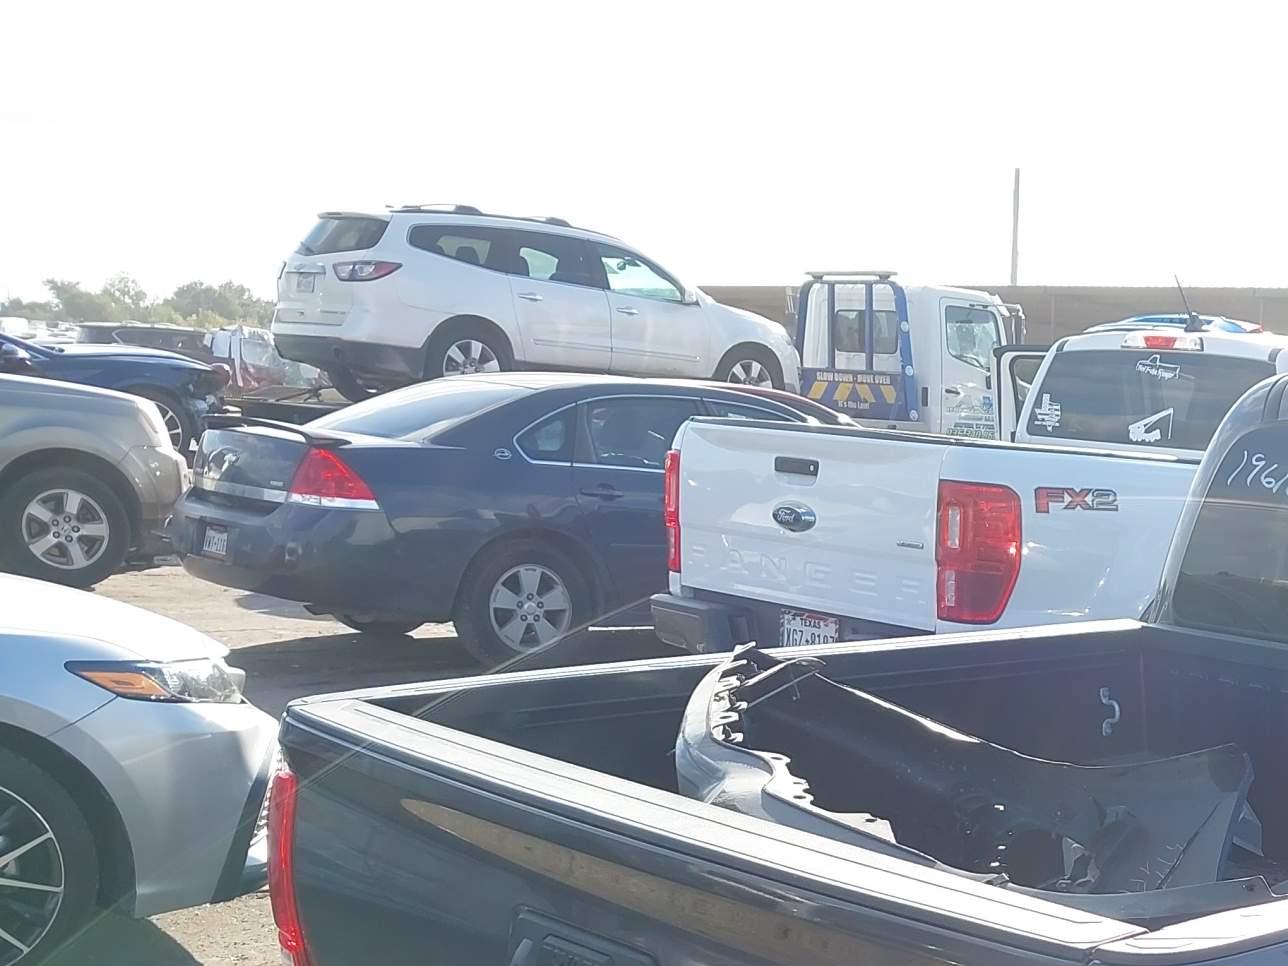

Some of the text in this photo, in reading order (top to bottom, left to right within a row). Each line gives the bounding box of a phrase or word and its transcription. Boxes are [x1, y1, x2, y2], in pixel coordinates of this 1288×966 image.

[816, 371, 833, 381] SLOW
[1034, 486, 1119, 514] FX2
[799, 617, 821, 629] TEXAS
